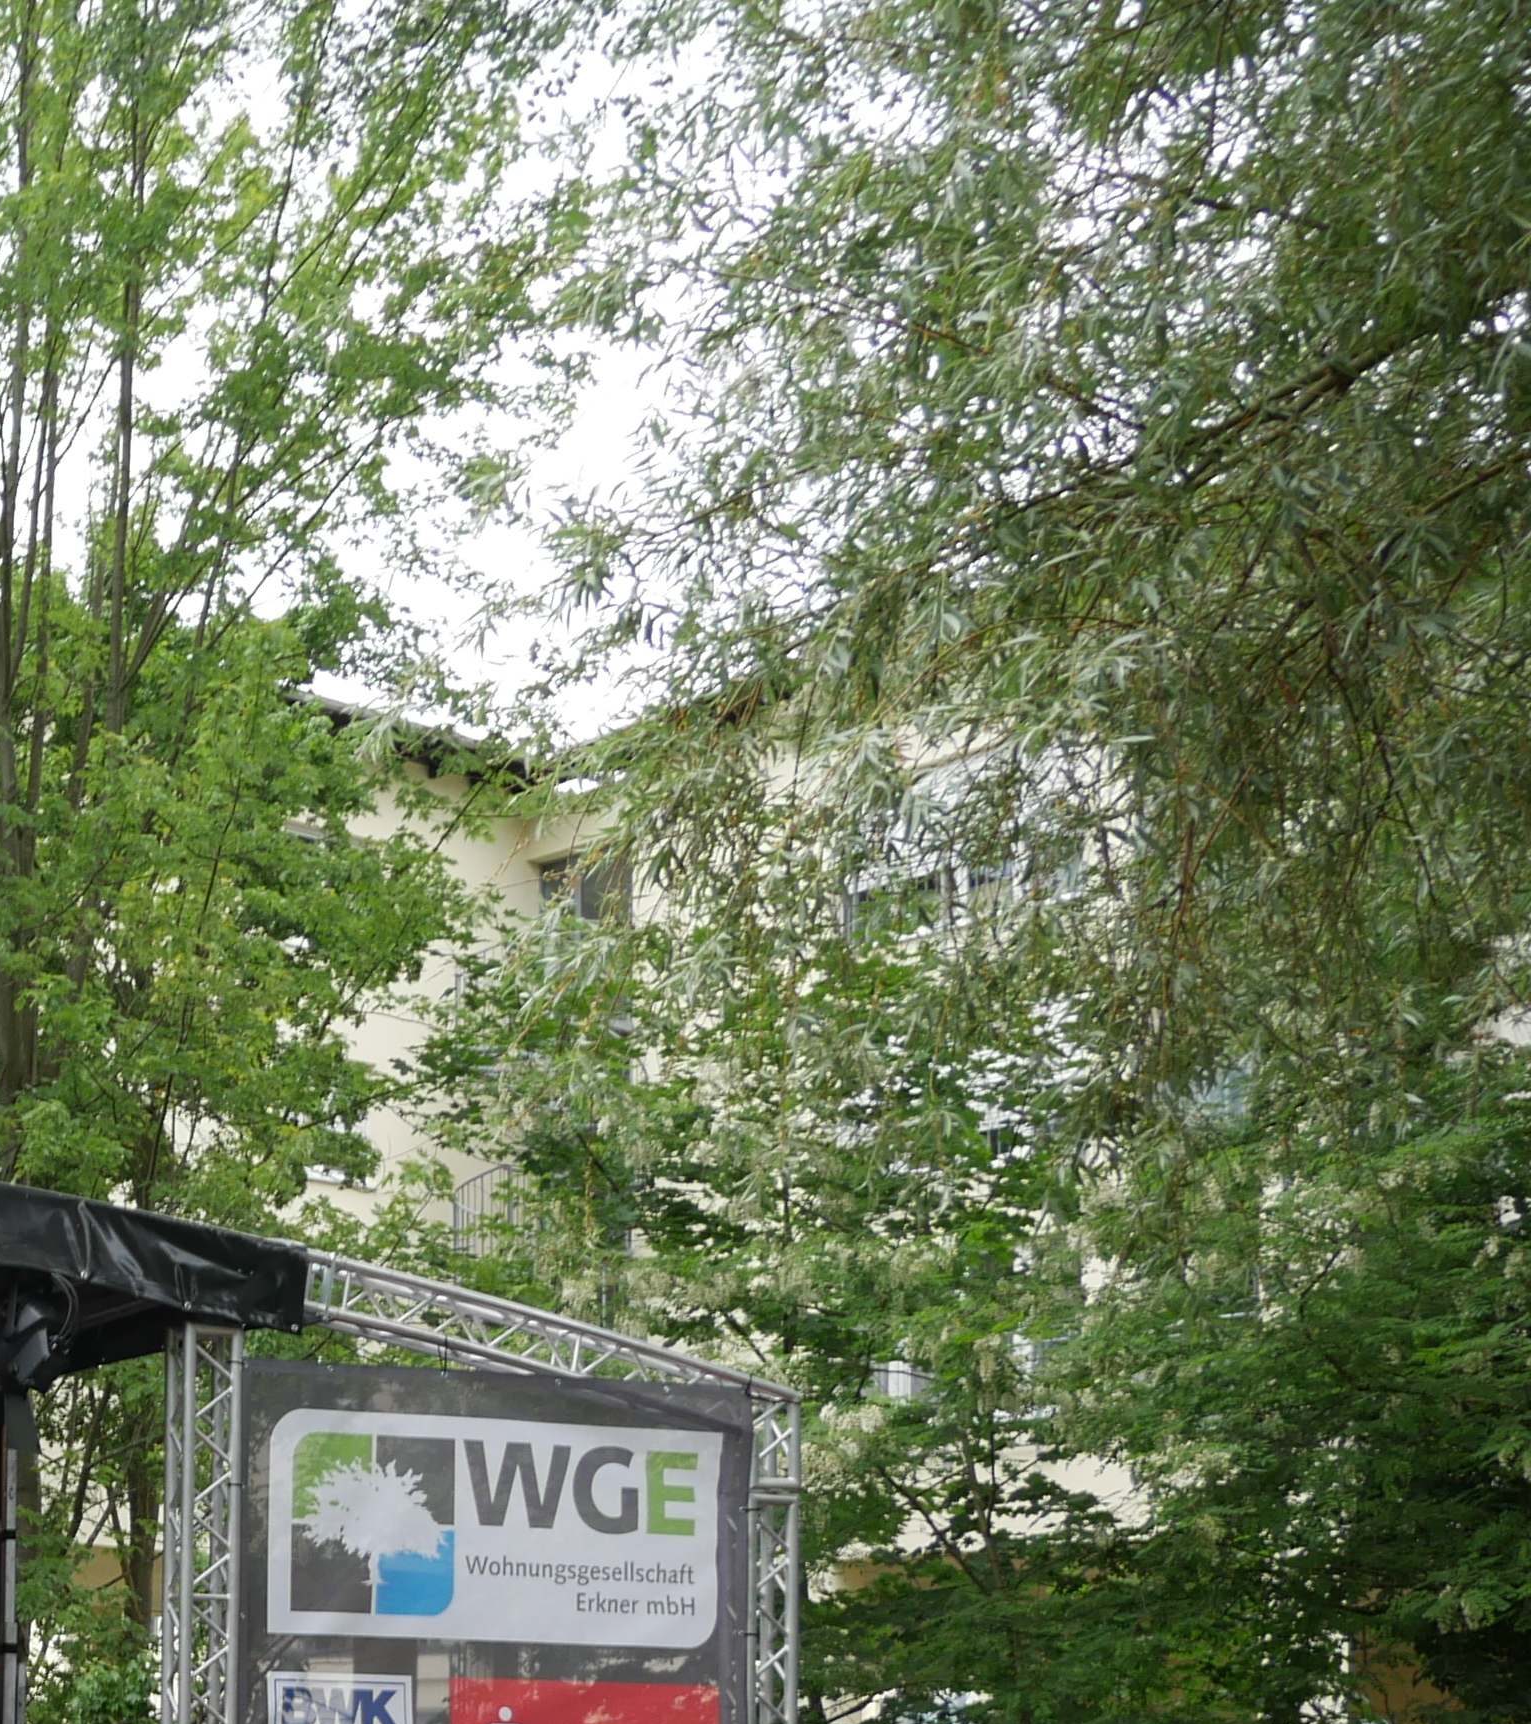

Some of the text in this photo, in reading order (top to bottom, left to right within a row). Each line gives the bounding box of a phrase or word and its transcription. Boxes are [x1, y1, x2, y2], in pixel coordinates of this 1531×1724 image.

[465, 1438, 698, 1536] WGE
[465, 1554, 695, 1584] Wohnungsgesellschaft
[575, 1592, 696, 1617] Erkner mbH
